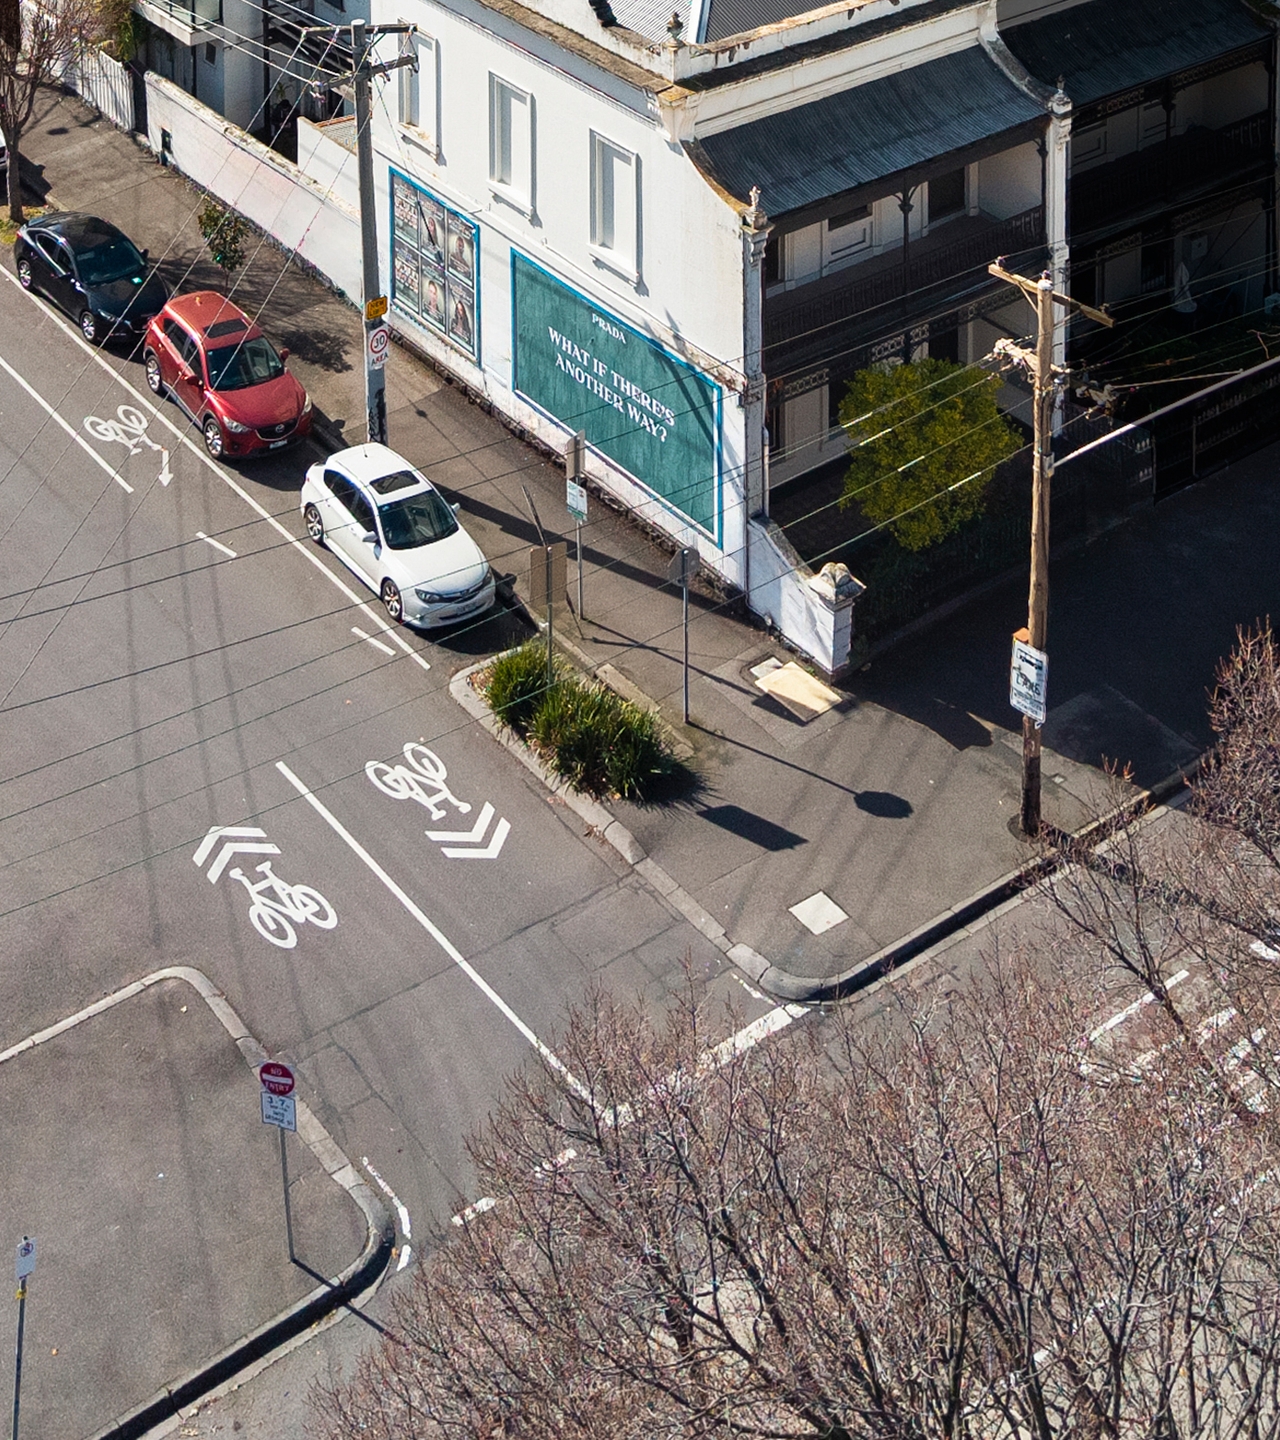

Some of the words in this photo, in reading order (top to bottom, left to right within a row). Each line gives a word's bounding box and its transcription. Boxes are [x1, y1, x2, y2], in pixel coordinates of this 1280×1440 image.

[591, 313, 626, 344] PRADA
[374, 335, 385, 348] 30
[371, 352, 388, 366] AREA
[548, 326, 590, 367] WHAT
[593, 357, 608, 377] IF
[611, 370, 676, 427] THERE'S
[555, 353, 625, 413] ANOTHER
[627, 402, 668, 442] WAY?
[270, 1067, 282, 1076] NO
[265, 1081, 289, 1092] ENTRY
